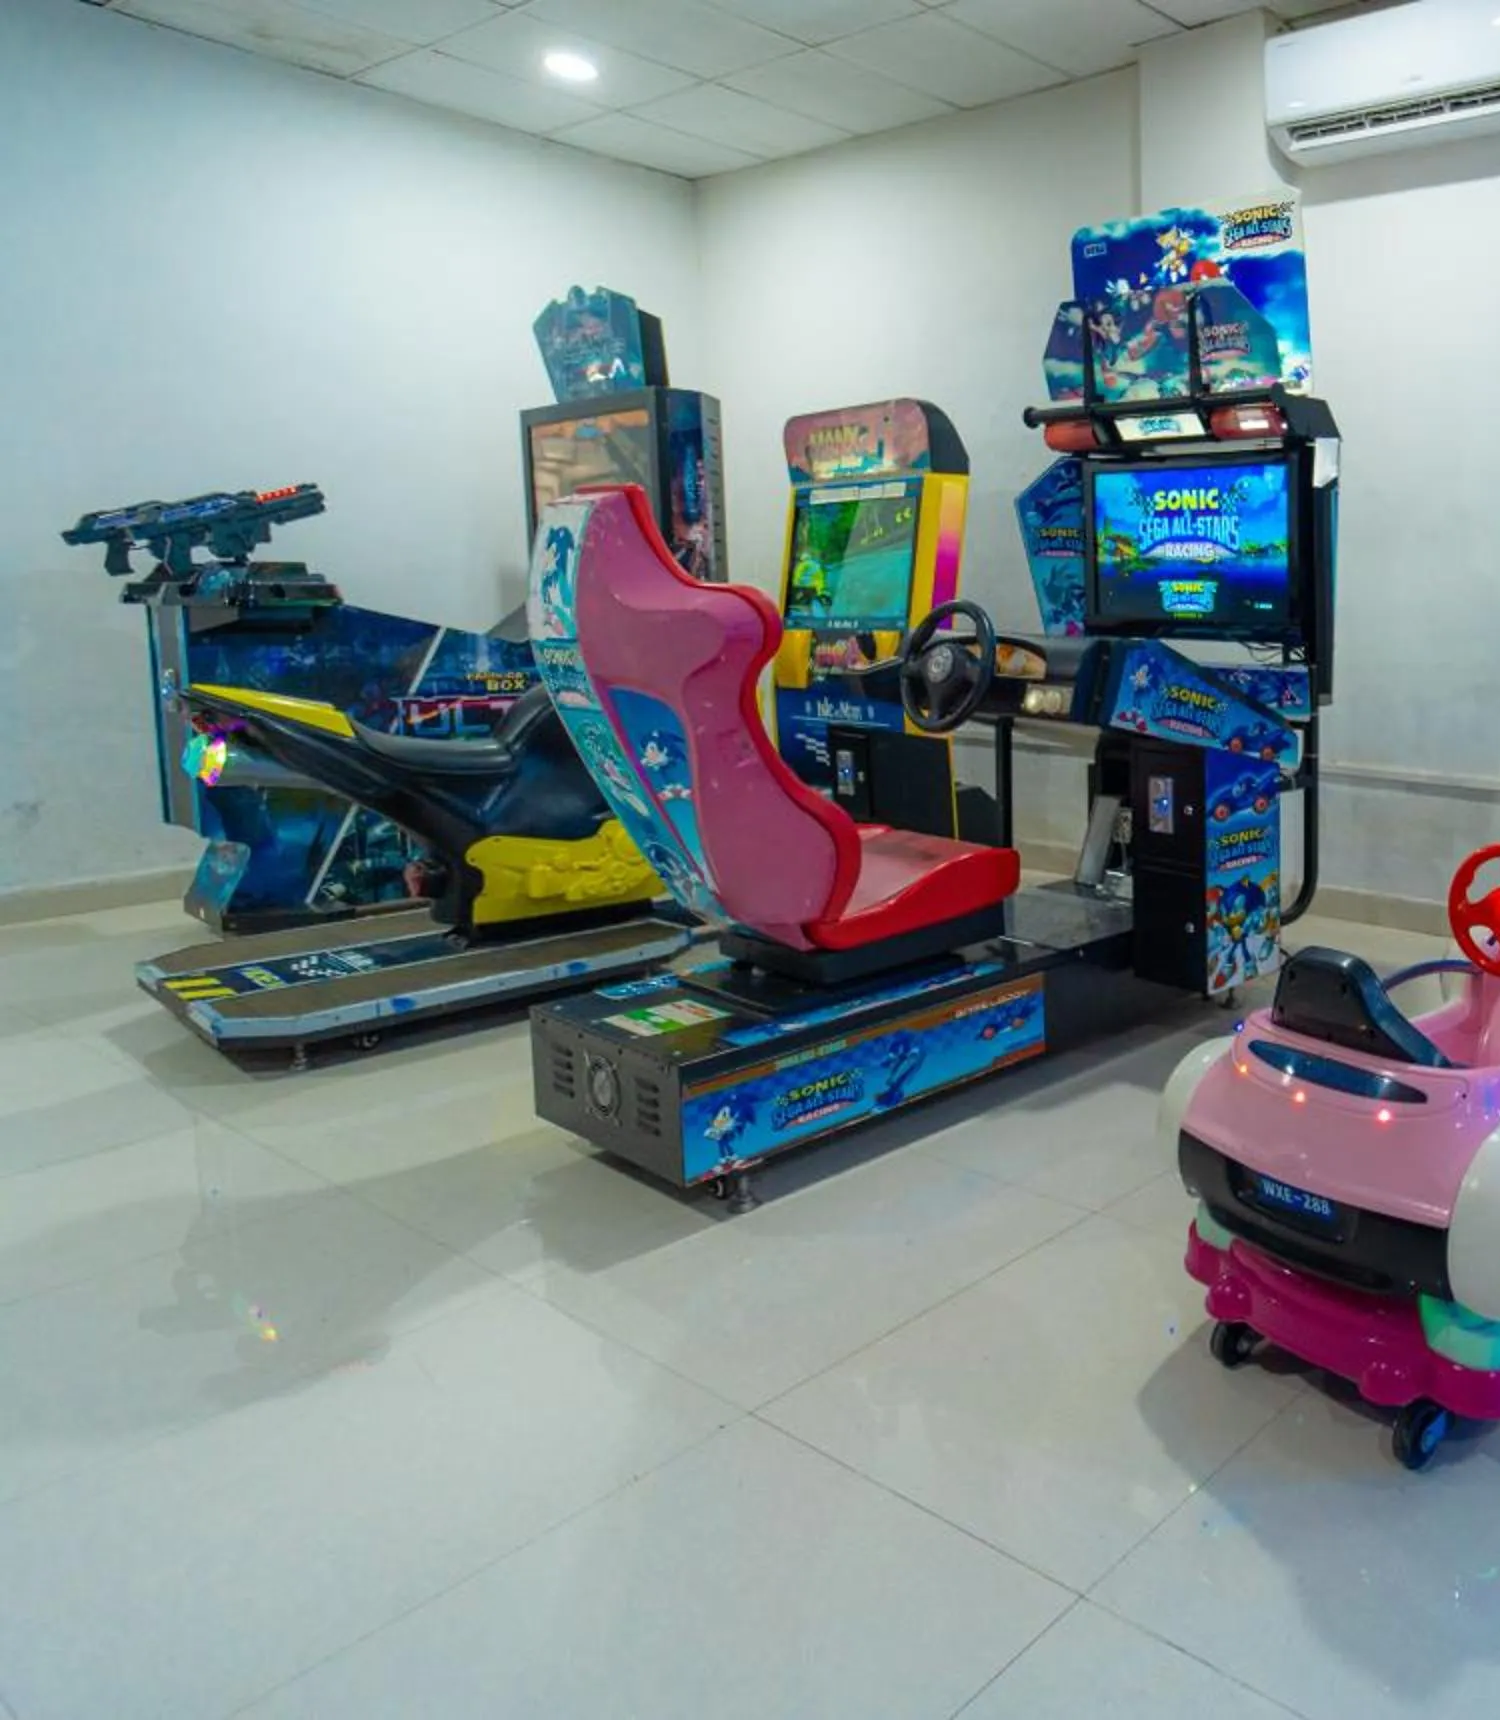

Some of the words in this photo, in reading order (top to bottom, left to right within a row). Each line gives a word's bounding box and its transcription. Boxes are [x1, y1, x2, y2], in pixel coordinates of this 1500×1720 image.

[1230, 204, 1279, 223] SONIC
[1154, 487, 1219, 511] SONIC
[1138, 516, 1170, 551] SEGA
[1164, 541, 1215, 560] RACING
[1167, 685, 1218, 710] SONIC
[1220, 828, 1264, 847] SONIC
[789, 1073, 848, 1100] SONIC
